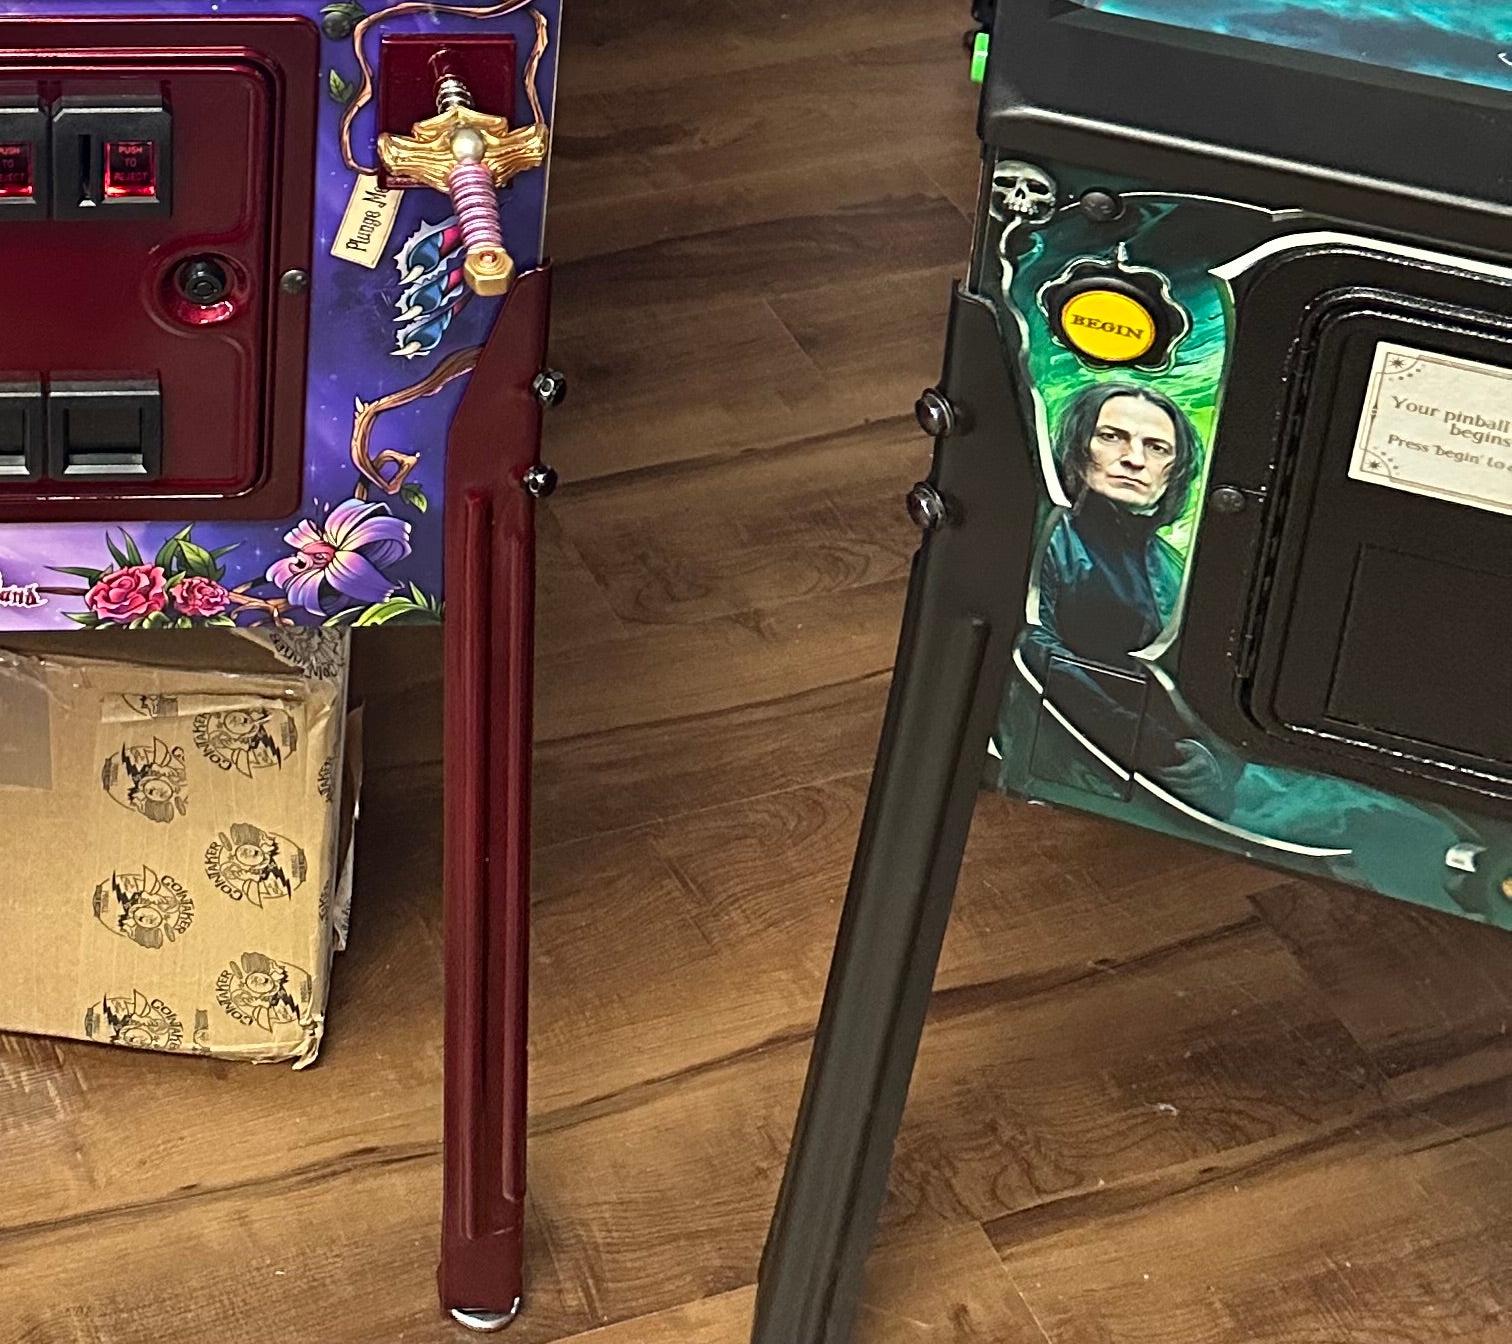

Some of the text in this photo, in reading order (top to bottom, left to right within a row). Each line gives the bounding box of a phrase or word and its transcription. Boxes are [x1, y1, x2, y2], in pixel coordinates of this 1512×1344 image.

[345, 210, 383, 252] Plunge
[1070, 314, 1144, 340] BEGIN
[1392, 395, 1511, 434] Your pinball
[1388, 434, 1429, 453] Press
[1486, 456, 1506, 470] to
[204, 842, 243, 901] COINTAKER
[161, 875, 195, 935] COINTAKER
[216, 969, 253, 1027] COINTAKER
